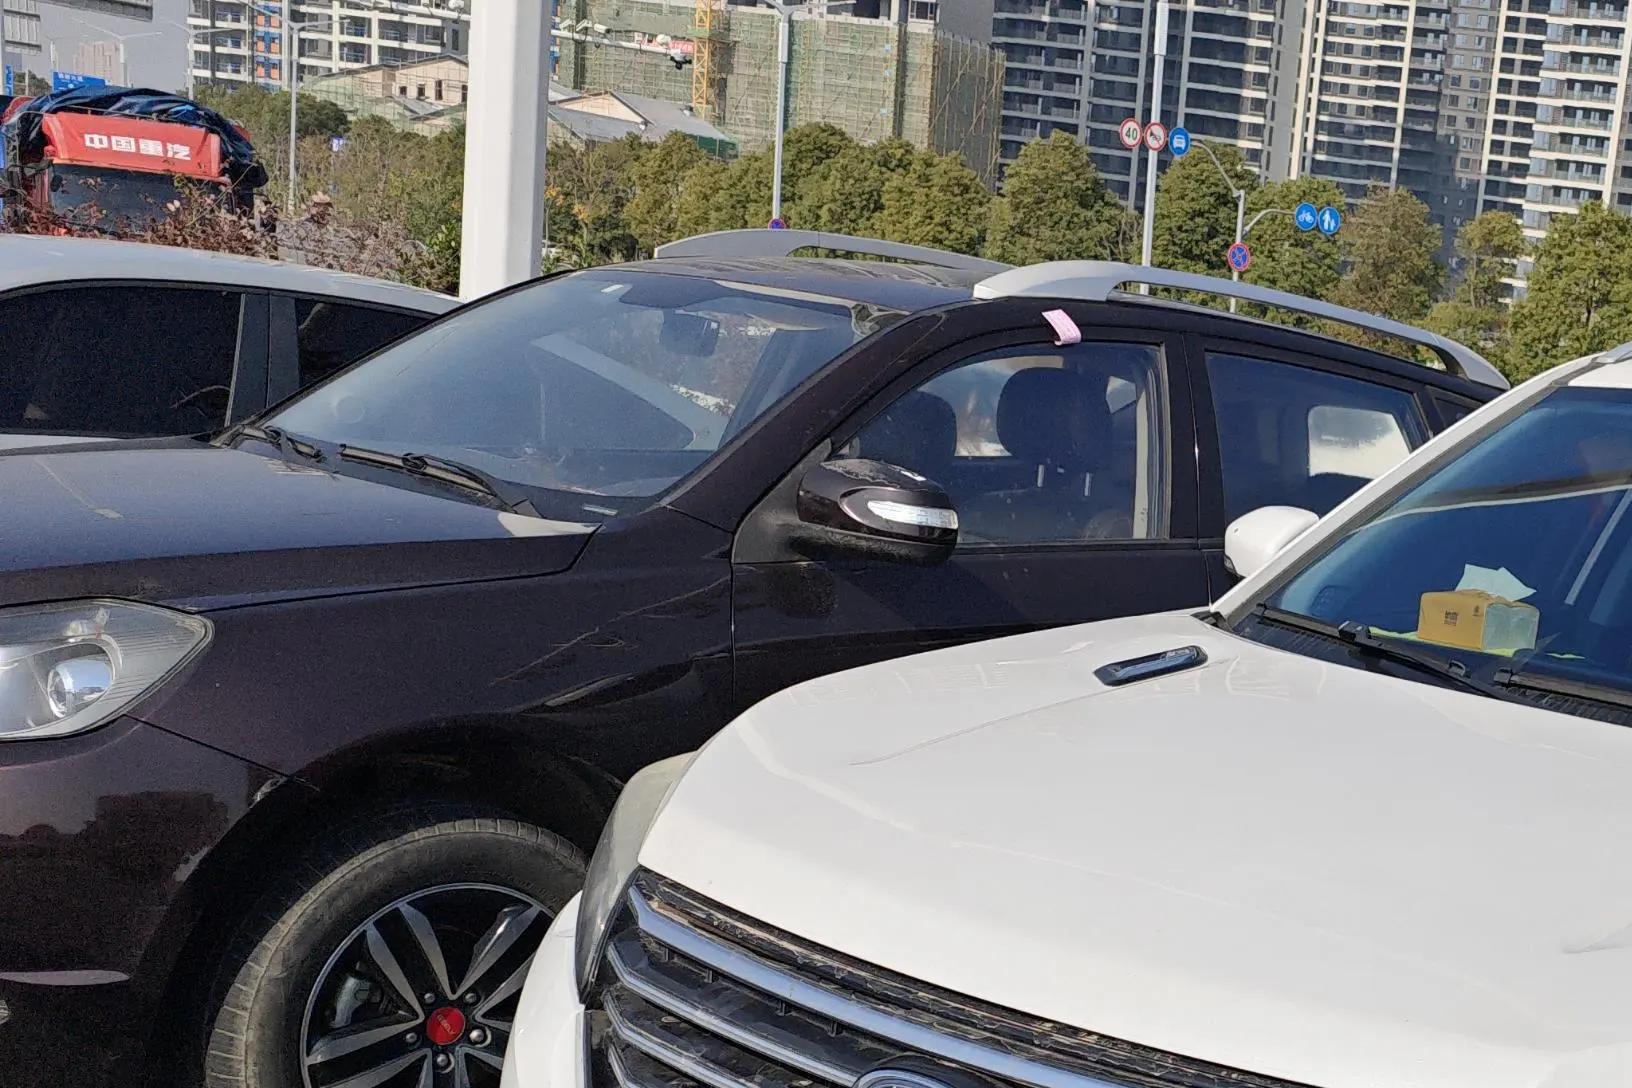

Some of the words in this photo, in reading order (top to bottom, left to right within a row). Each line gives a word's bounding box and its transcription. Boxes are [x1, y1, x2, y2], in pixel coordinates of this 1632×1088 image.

[1125, 127, 1138, 140] 40
[84, 133, 192, 161] 中国重汽
